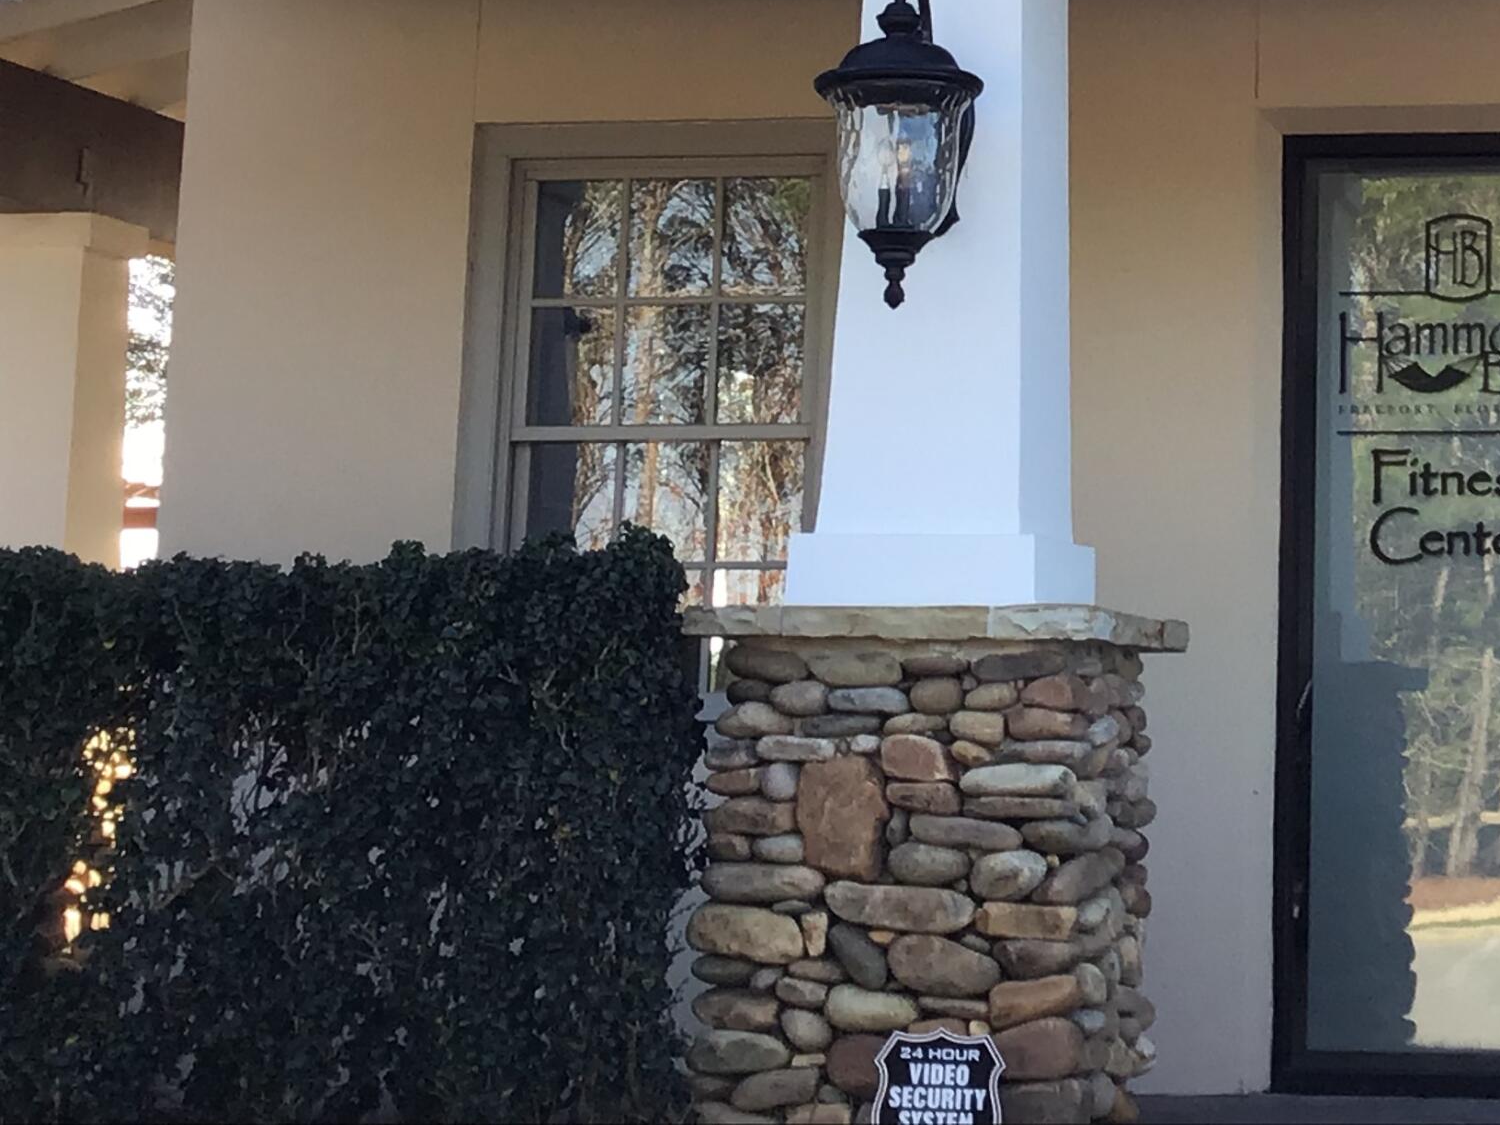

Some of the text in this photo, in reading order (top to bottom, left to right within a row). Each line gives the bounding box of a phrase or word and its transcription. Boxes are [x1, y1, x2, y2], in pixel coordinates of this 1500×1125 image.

[1427, 229, 1484, 288] HB
[899, 1047, 981, 1062] 24 HOUR
[908, 1062, 970, 1087] VIDEO
[888, 1085, 987, 1112] SECURITY
